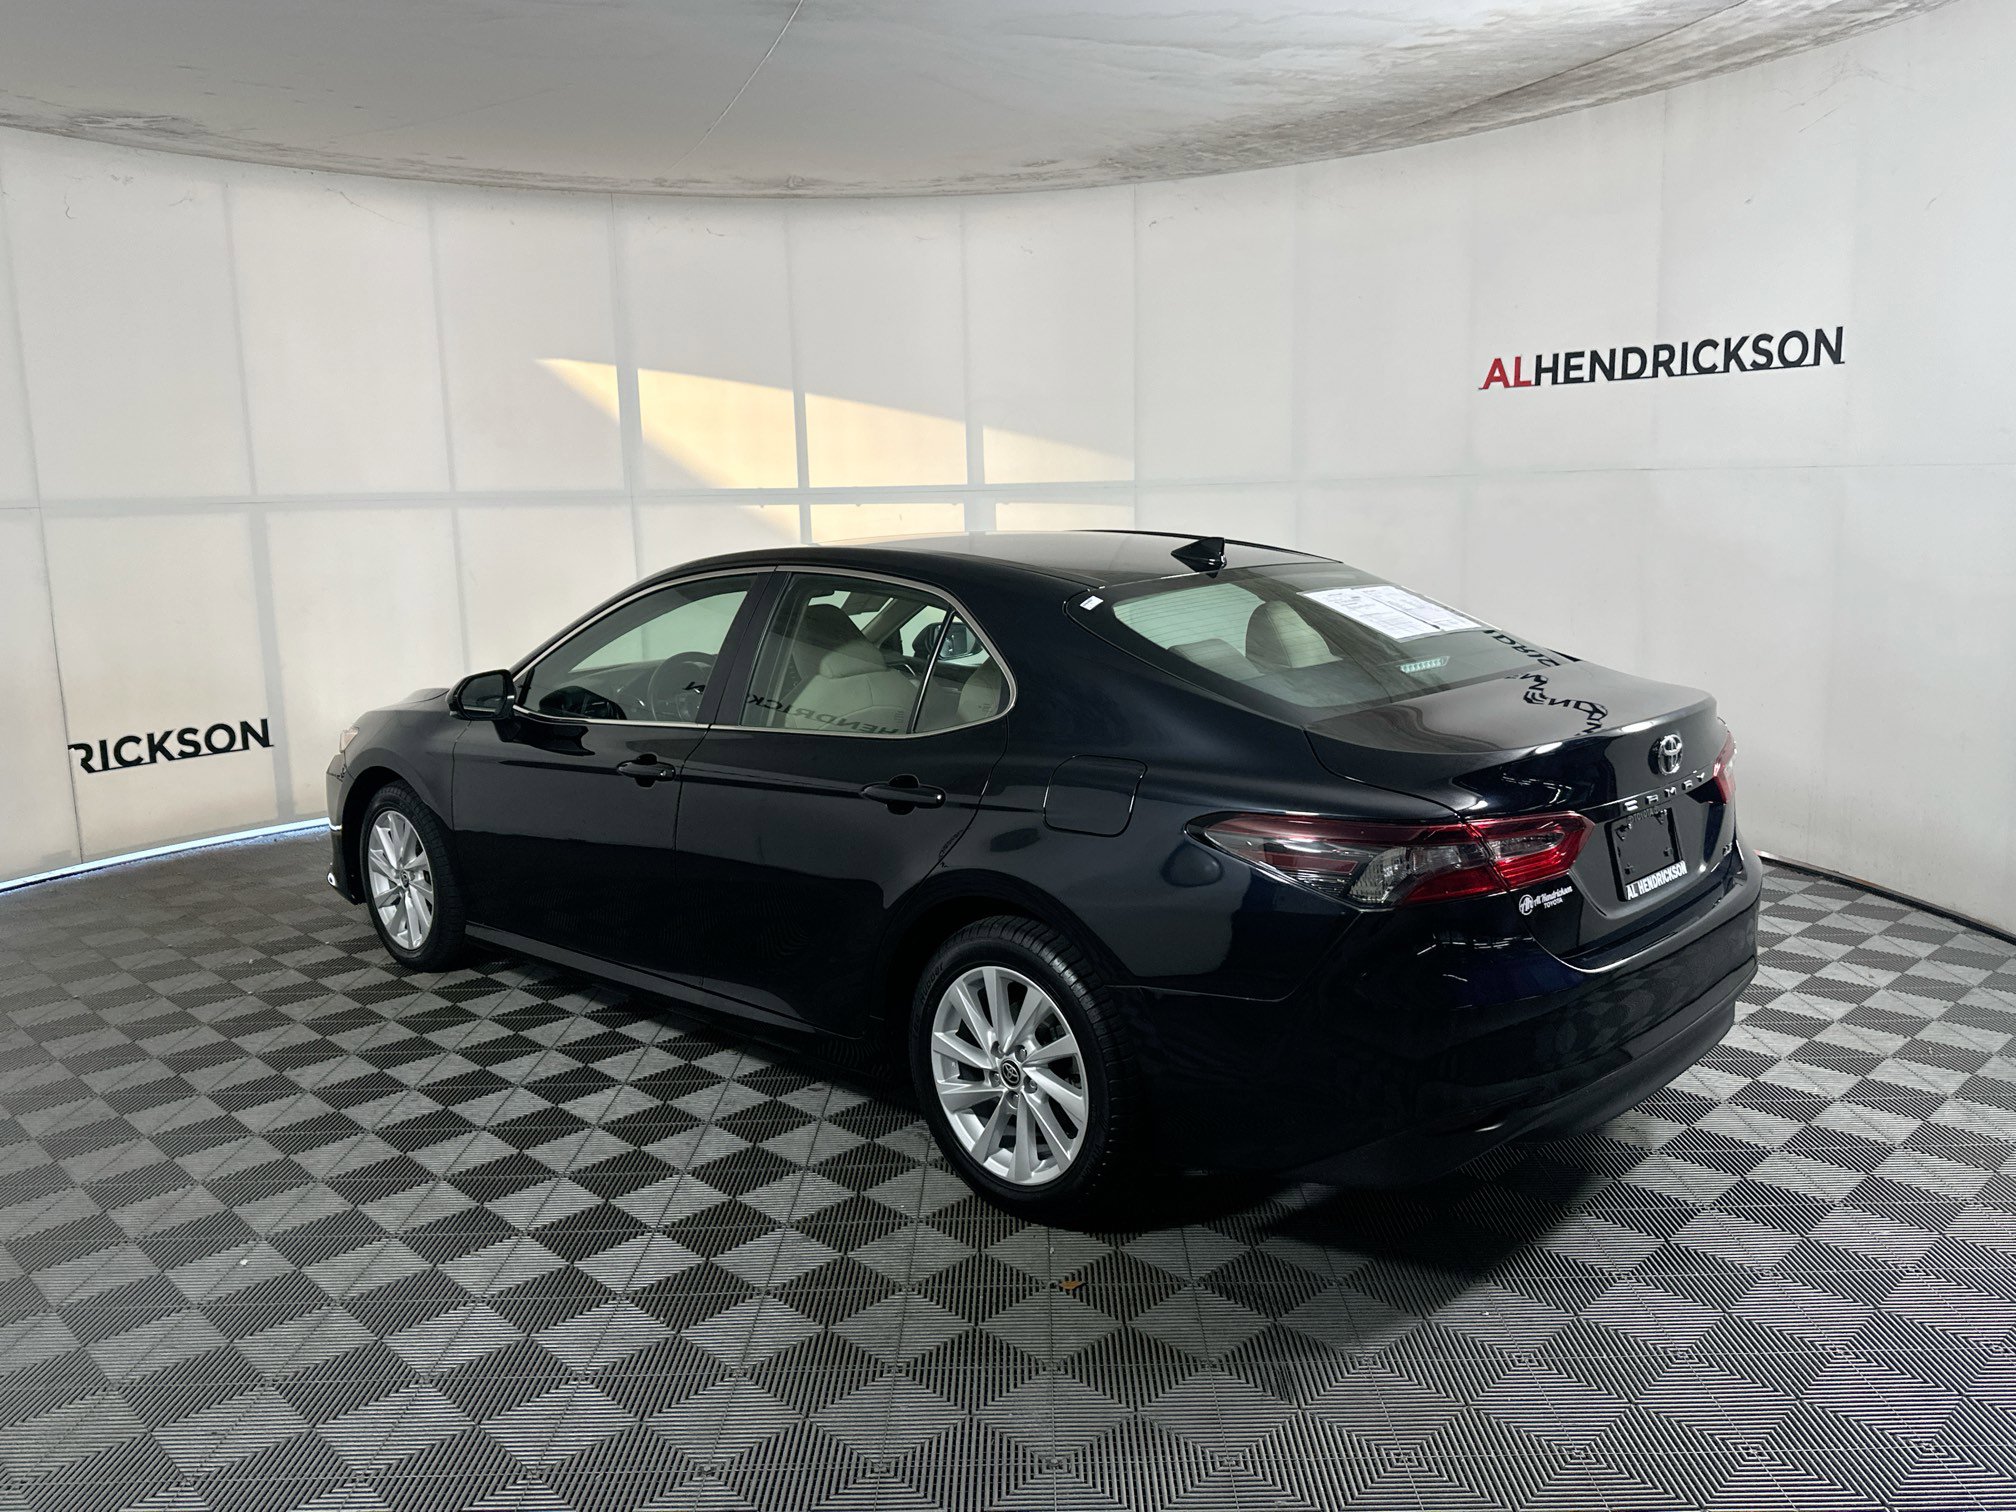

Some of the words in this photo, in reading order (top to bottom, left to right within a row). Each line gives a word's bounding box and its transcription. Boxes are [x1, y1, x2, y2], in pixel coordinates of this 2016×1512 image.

[1626, 882, 1639, 900] AL
[1637, 860, 1688, 895] HENDRICKSON
[1544, 897, 1563, 909] TOYOTA
